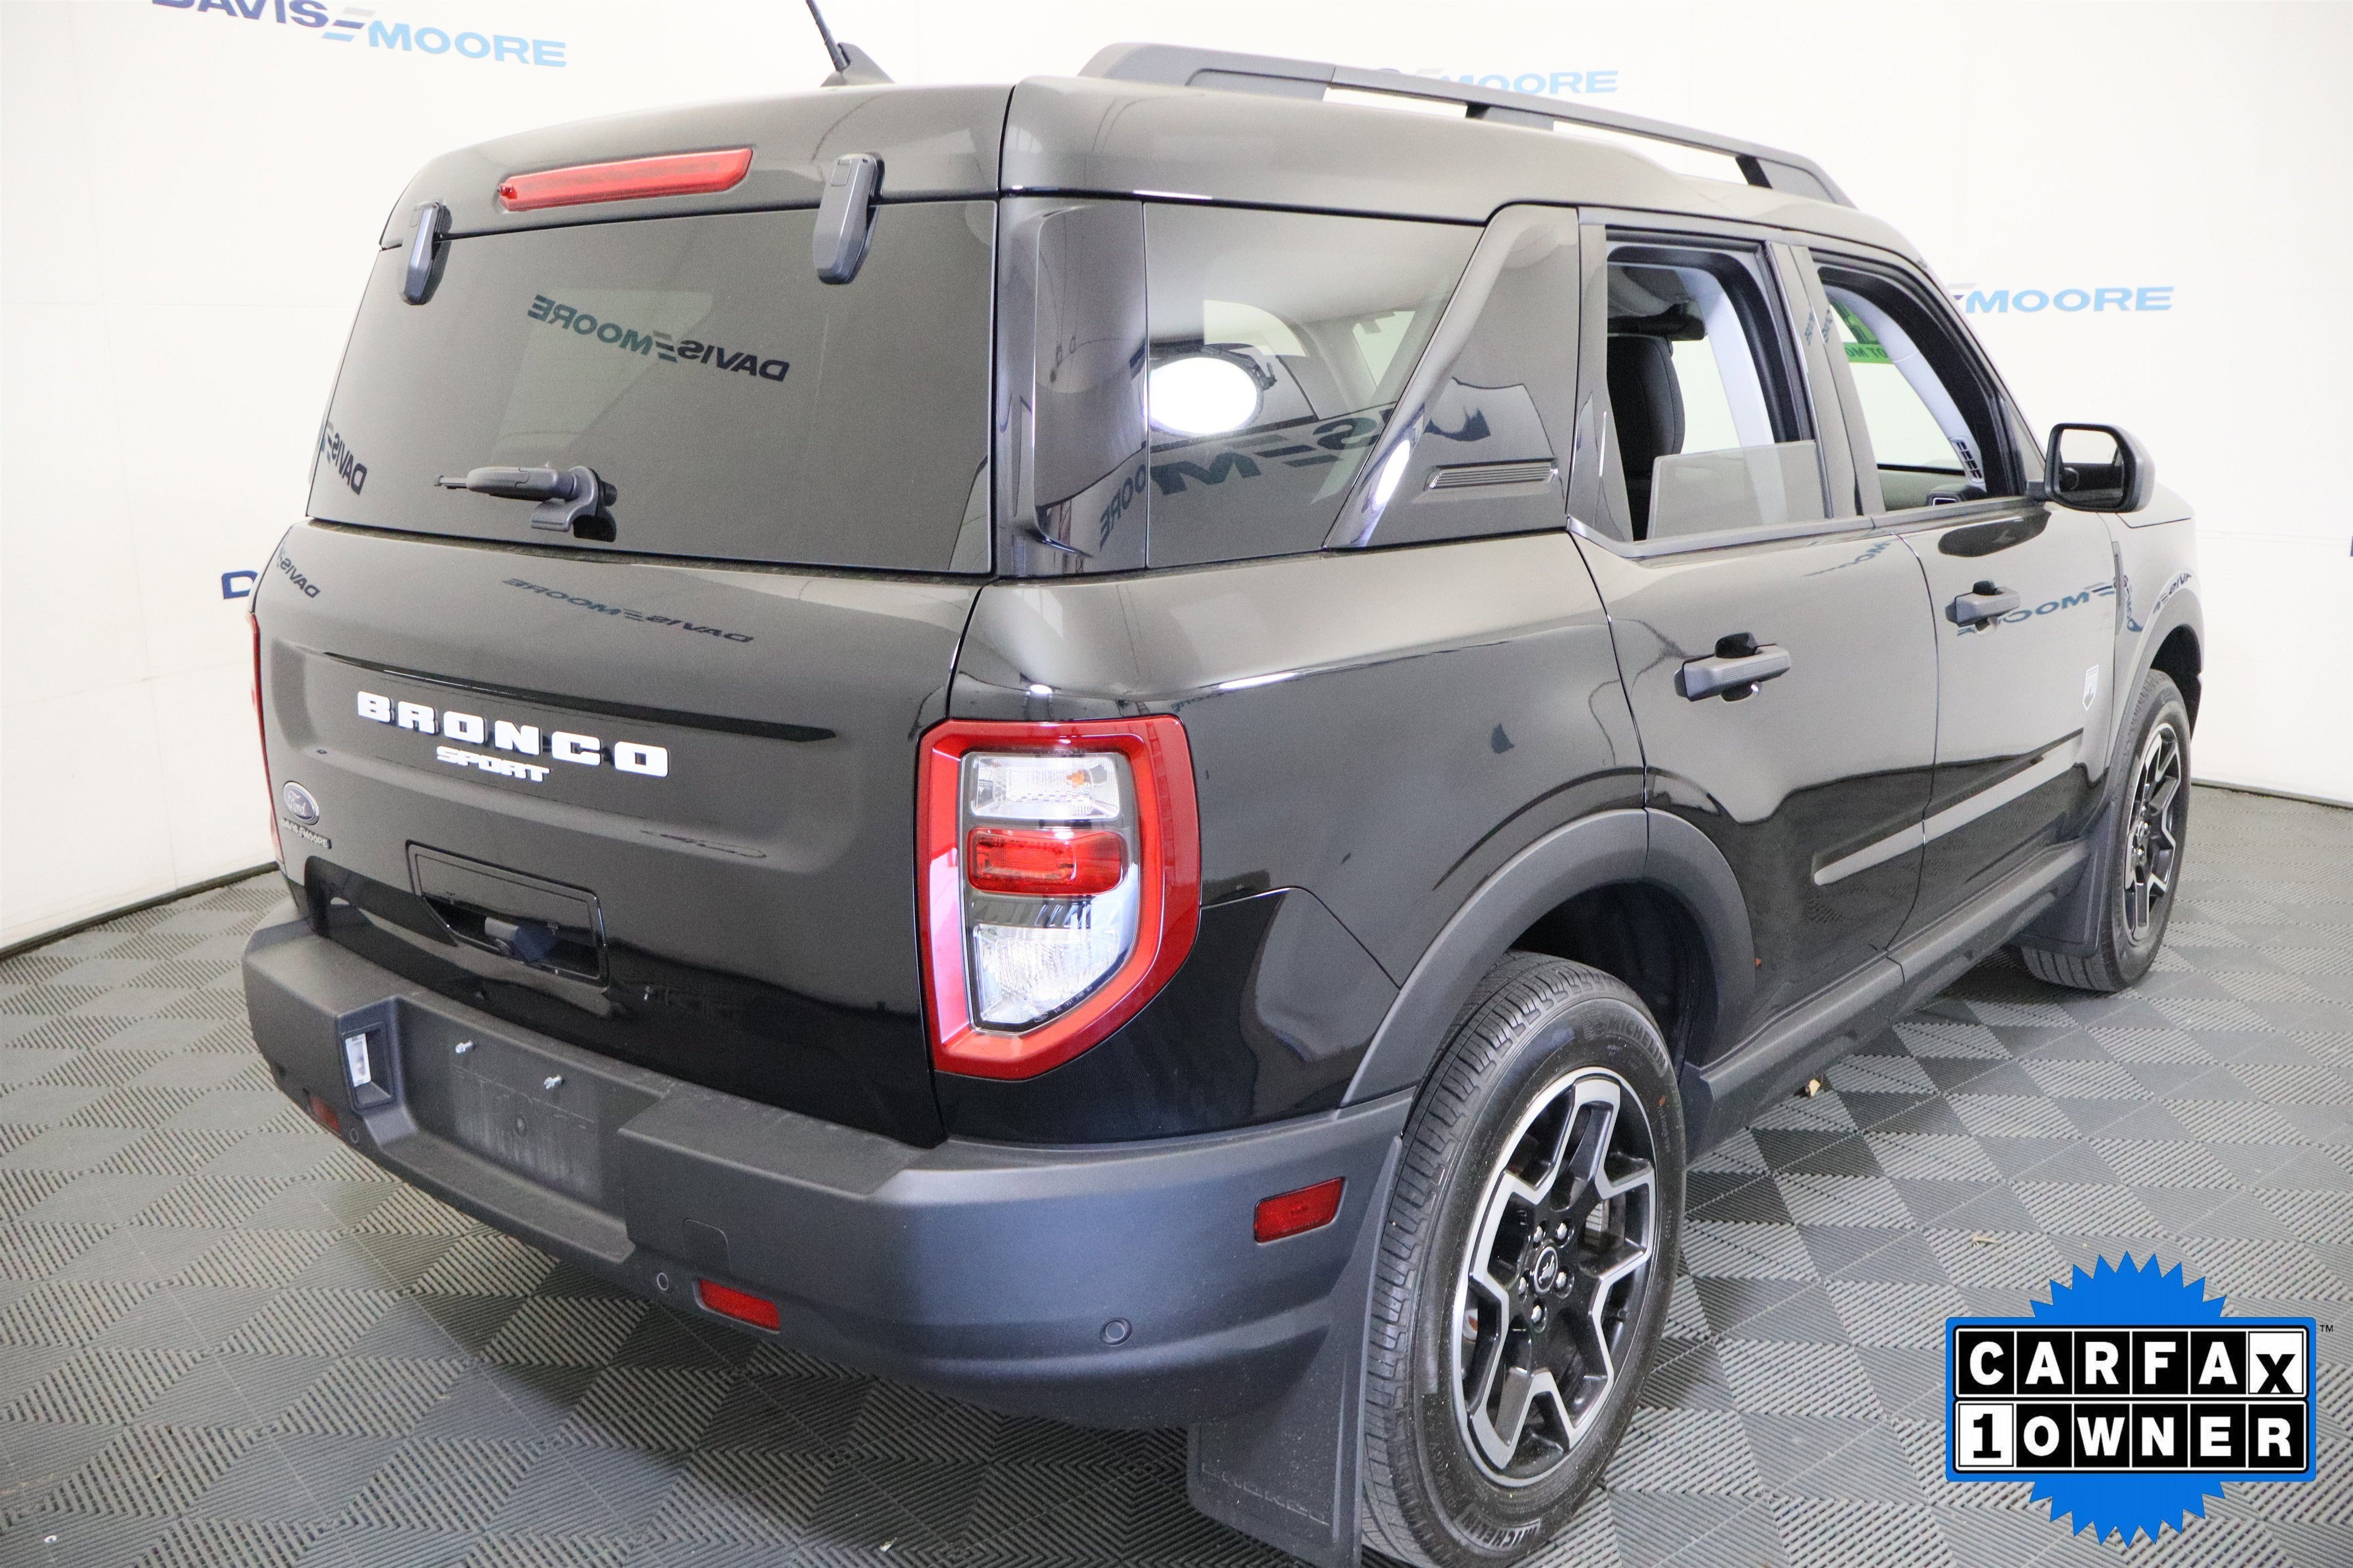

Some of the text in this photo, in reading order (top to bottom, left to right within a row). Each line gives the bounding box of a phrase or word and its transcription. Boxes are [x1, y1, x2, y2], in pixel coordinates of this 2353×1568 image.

[368, 20, 567, 67] MOORE
[1965, 286, 2175, 314] MOORE
[357, 690, 670, 778] BRONCO
[437, 746, 551, 782] SPORT
[1459, 1510, 1541, 1548] MICHELIN
